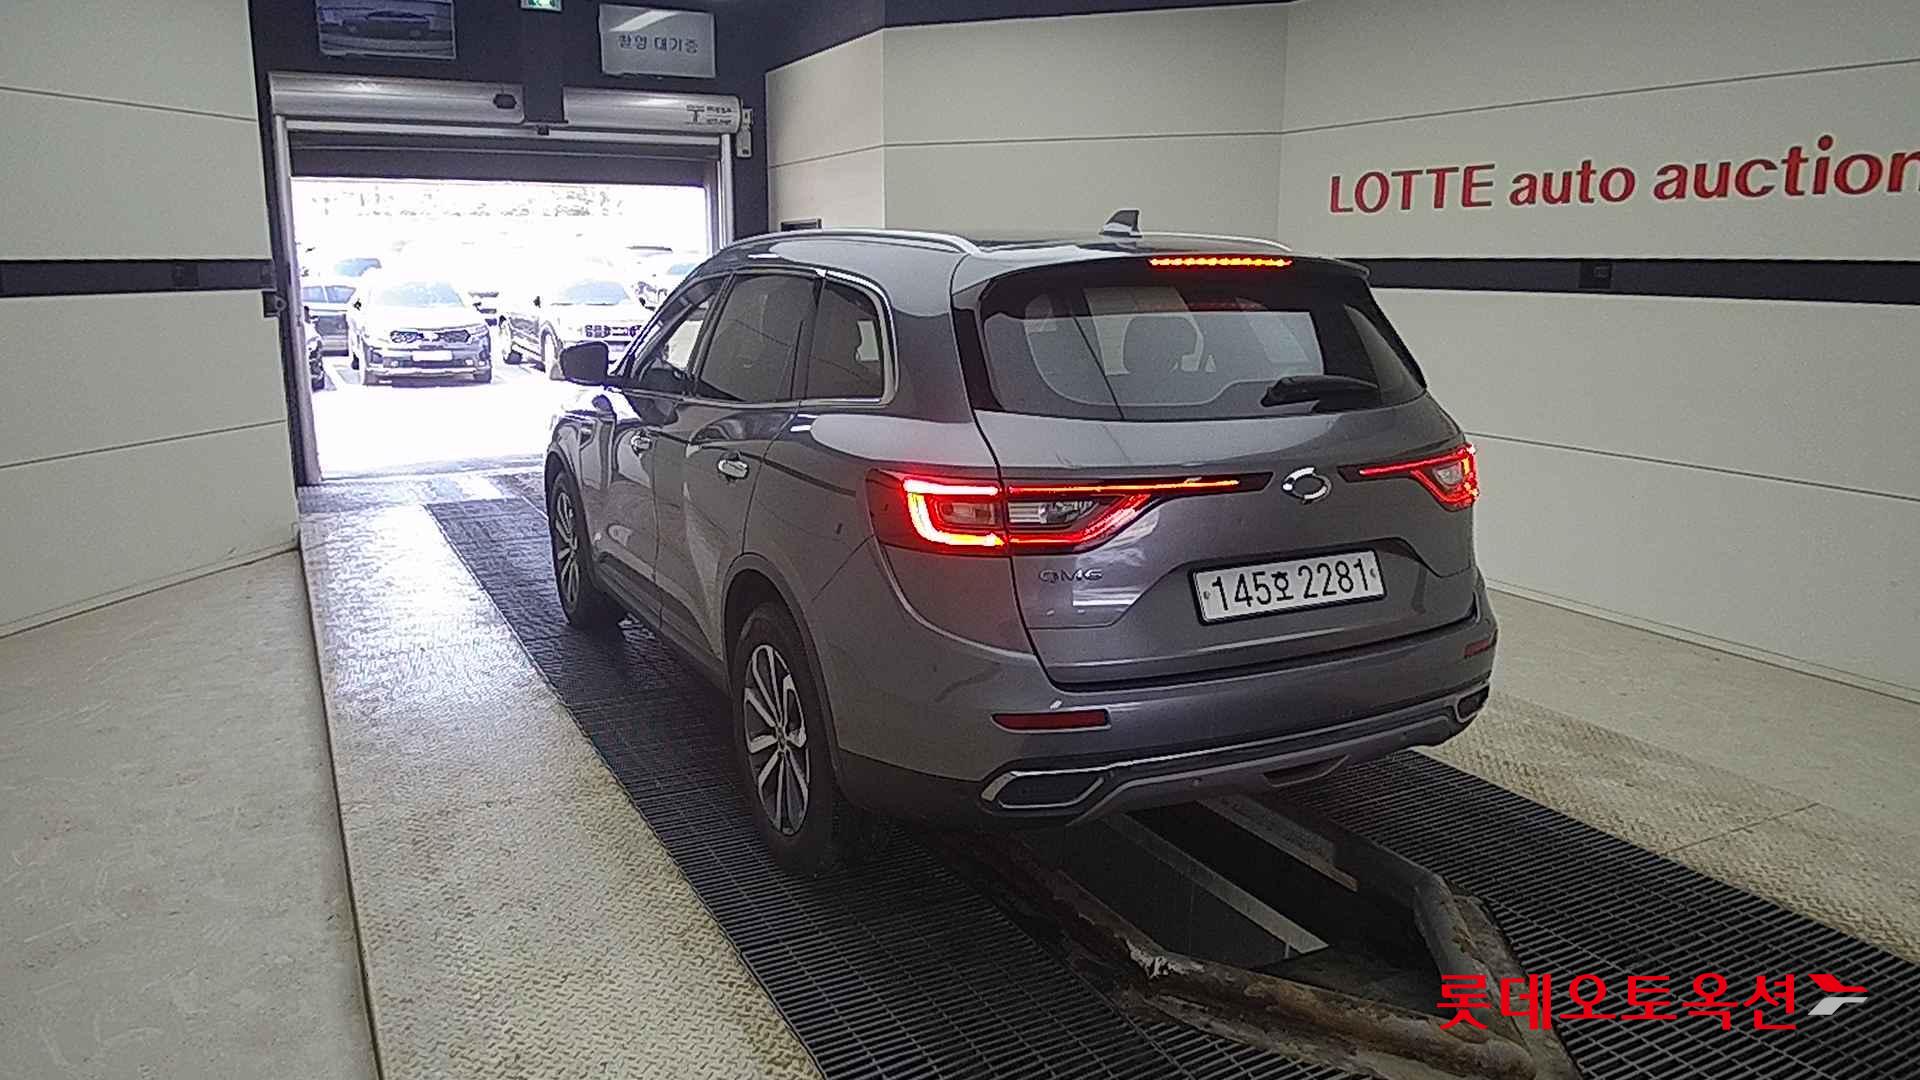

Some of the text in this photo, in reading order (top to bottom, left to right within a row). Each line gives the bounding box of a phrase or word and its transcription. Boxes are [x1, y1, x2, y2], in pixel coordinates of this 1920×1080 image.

[654, 36, 699, 54] 대기중
[1329, 163, 1496, 214] LOTTE
[1510, 159, 1636, 206] auto
[1297, 558, 1369, 599] 2281
